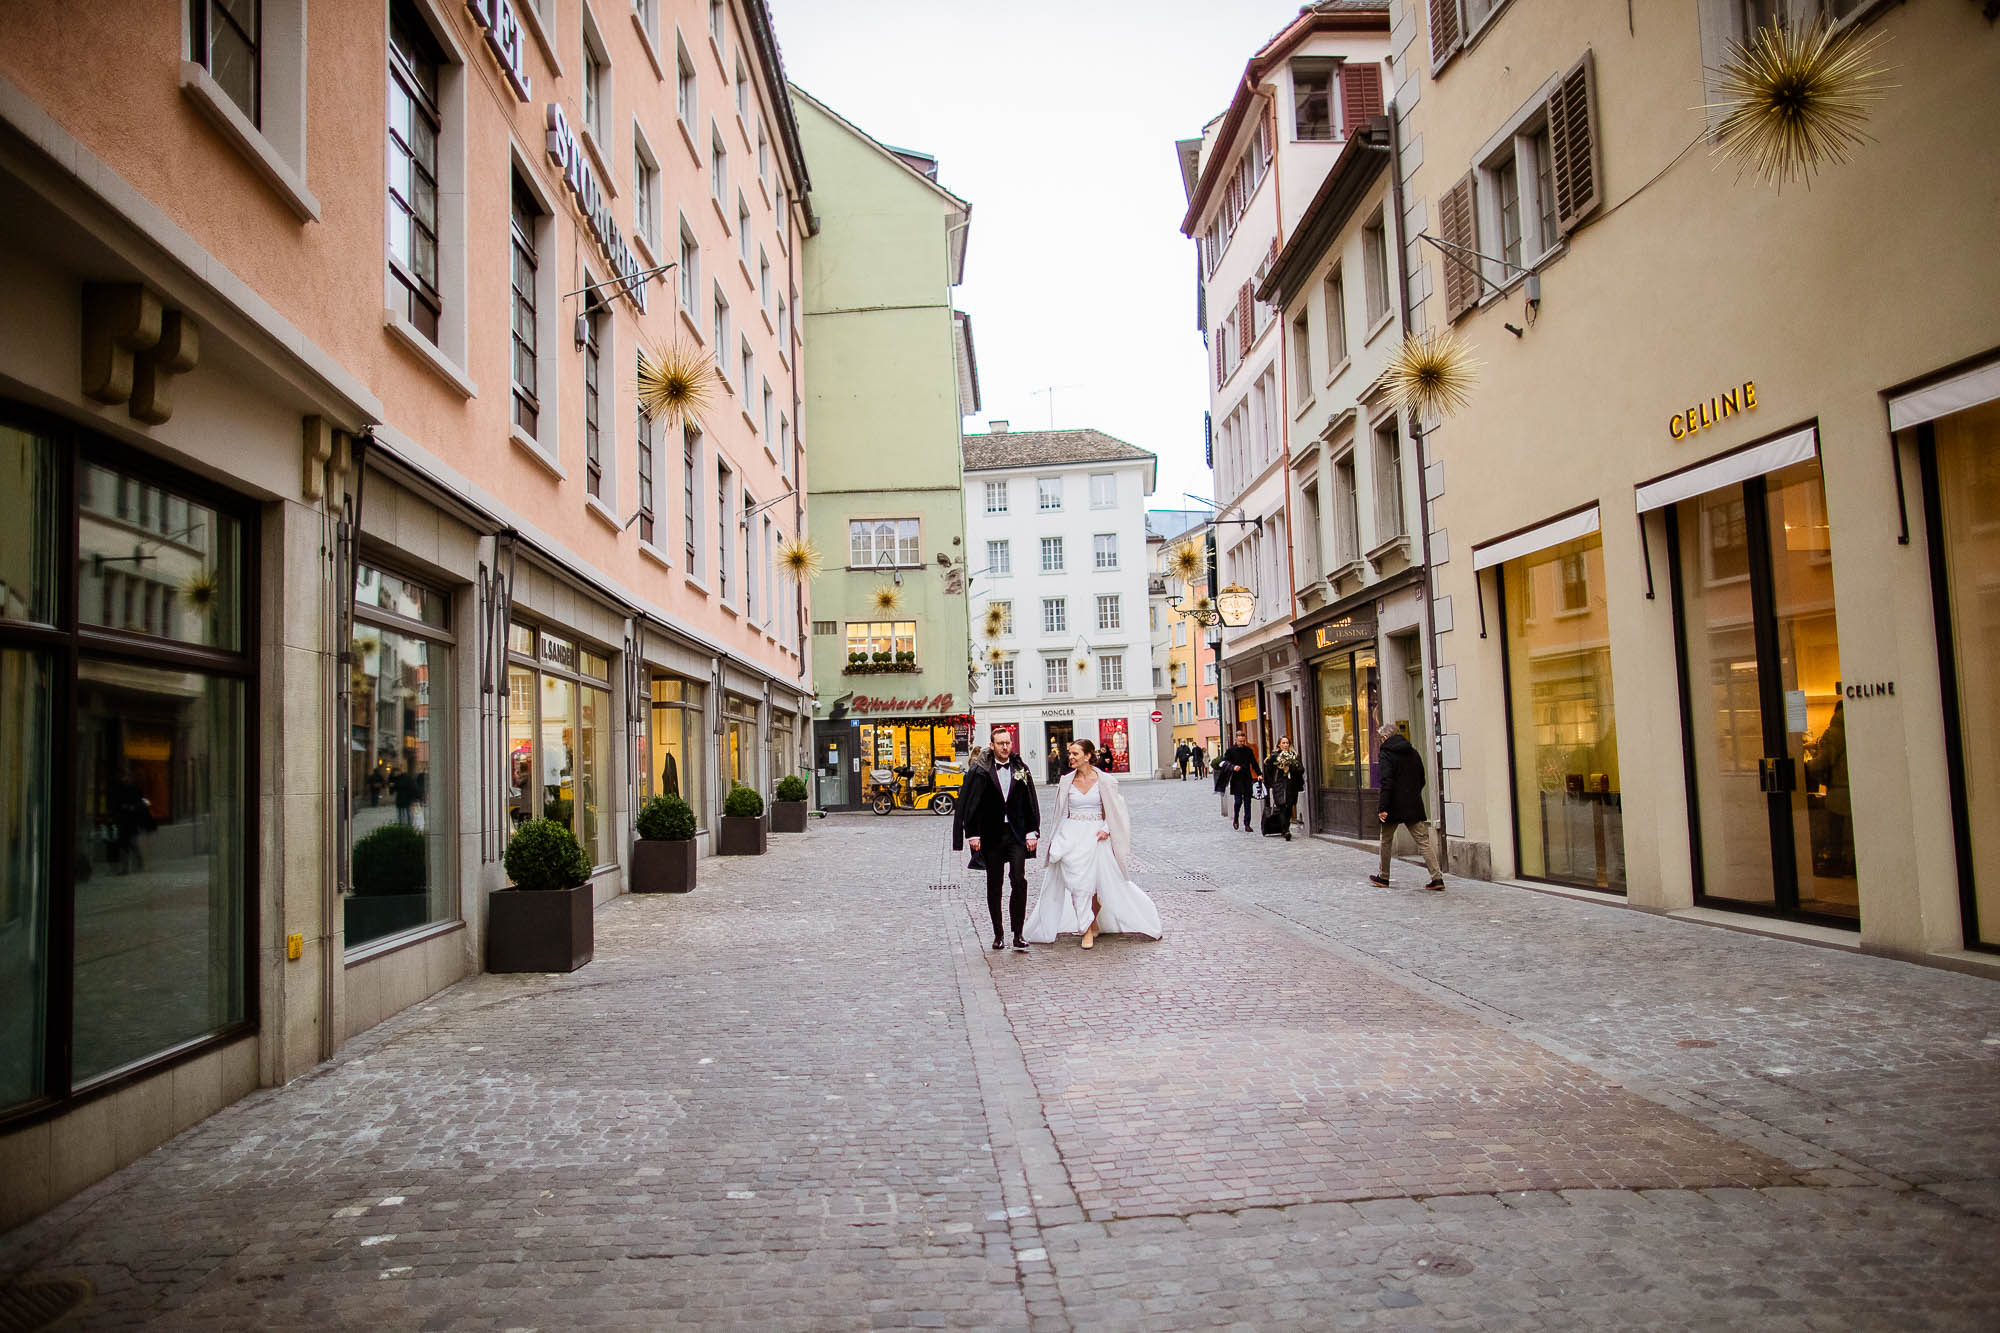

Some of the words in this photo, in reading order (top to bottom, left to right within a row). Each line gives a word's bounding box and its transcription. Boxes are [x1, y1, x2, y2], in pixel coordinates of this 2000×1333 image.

[467, 0, 532, 103] EL
[547, 103, 647, 315] STORCHEN
[1669, 381, 1757, 439] CELINE
[927, 693, 954, 712] AG
[1845, 681, 1896, 699] CELINE
[1041, 709, 1075, 717] MONCLER
